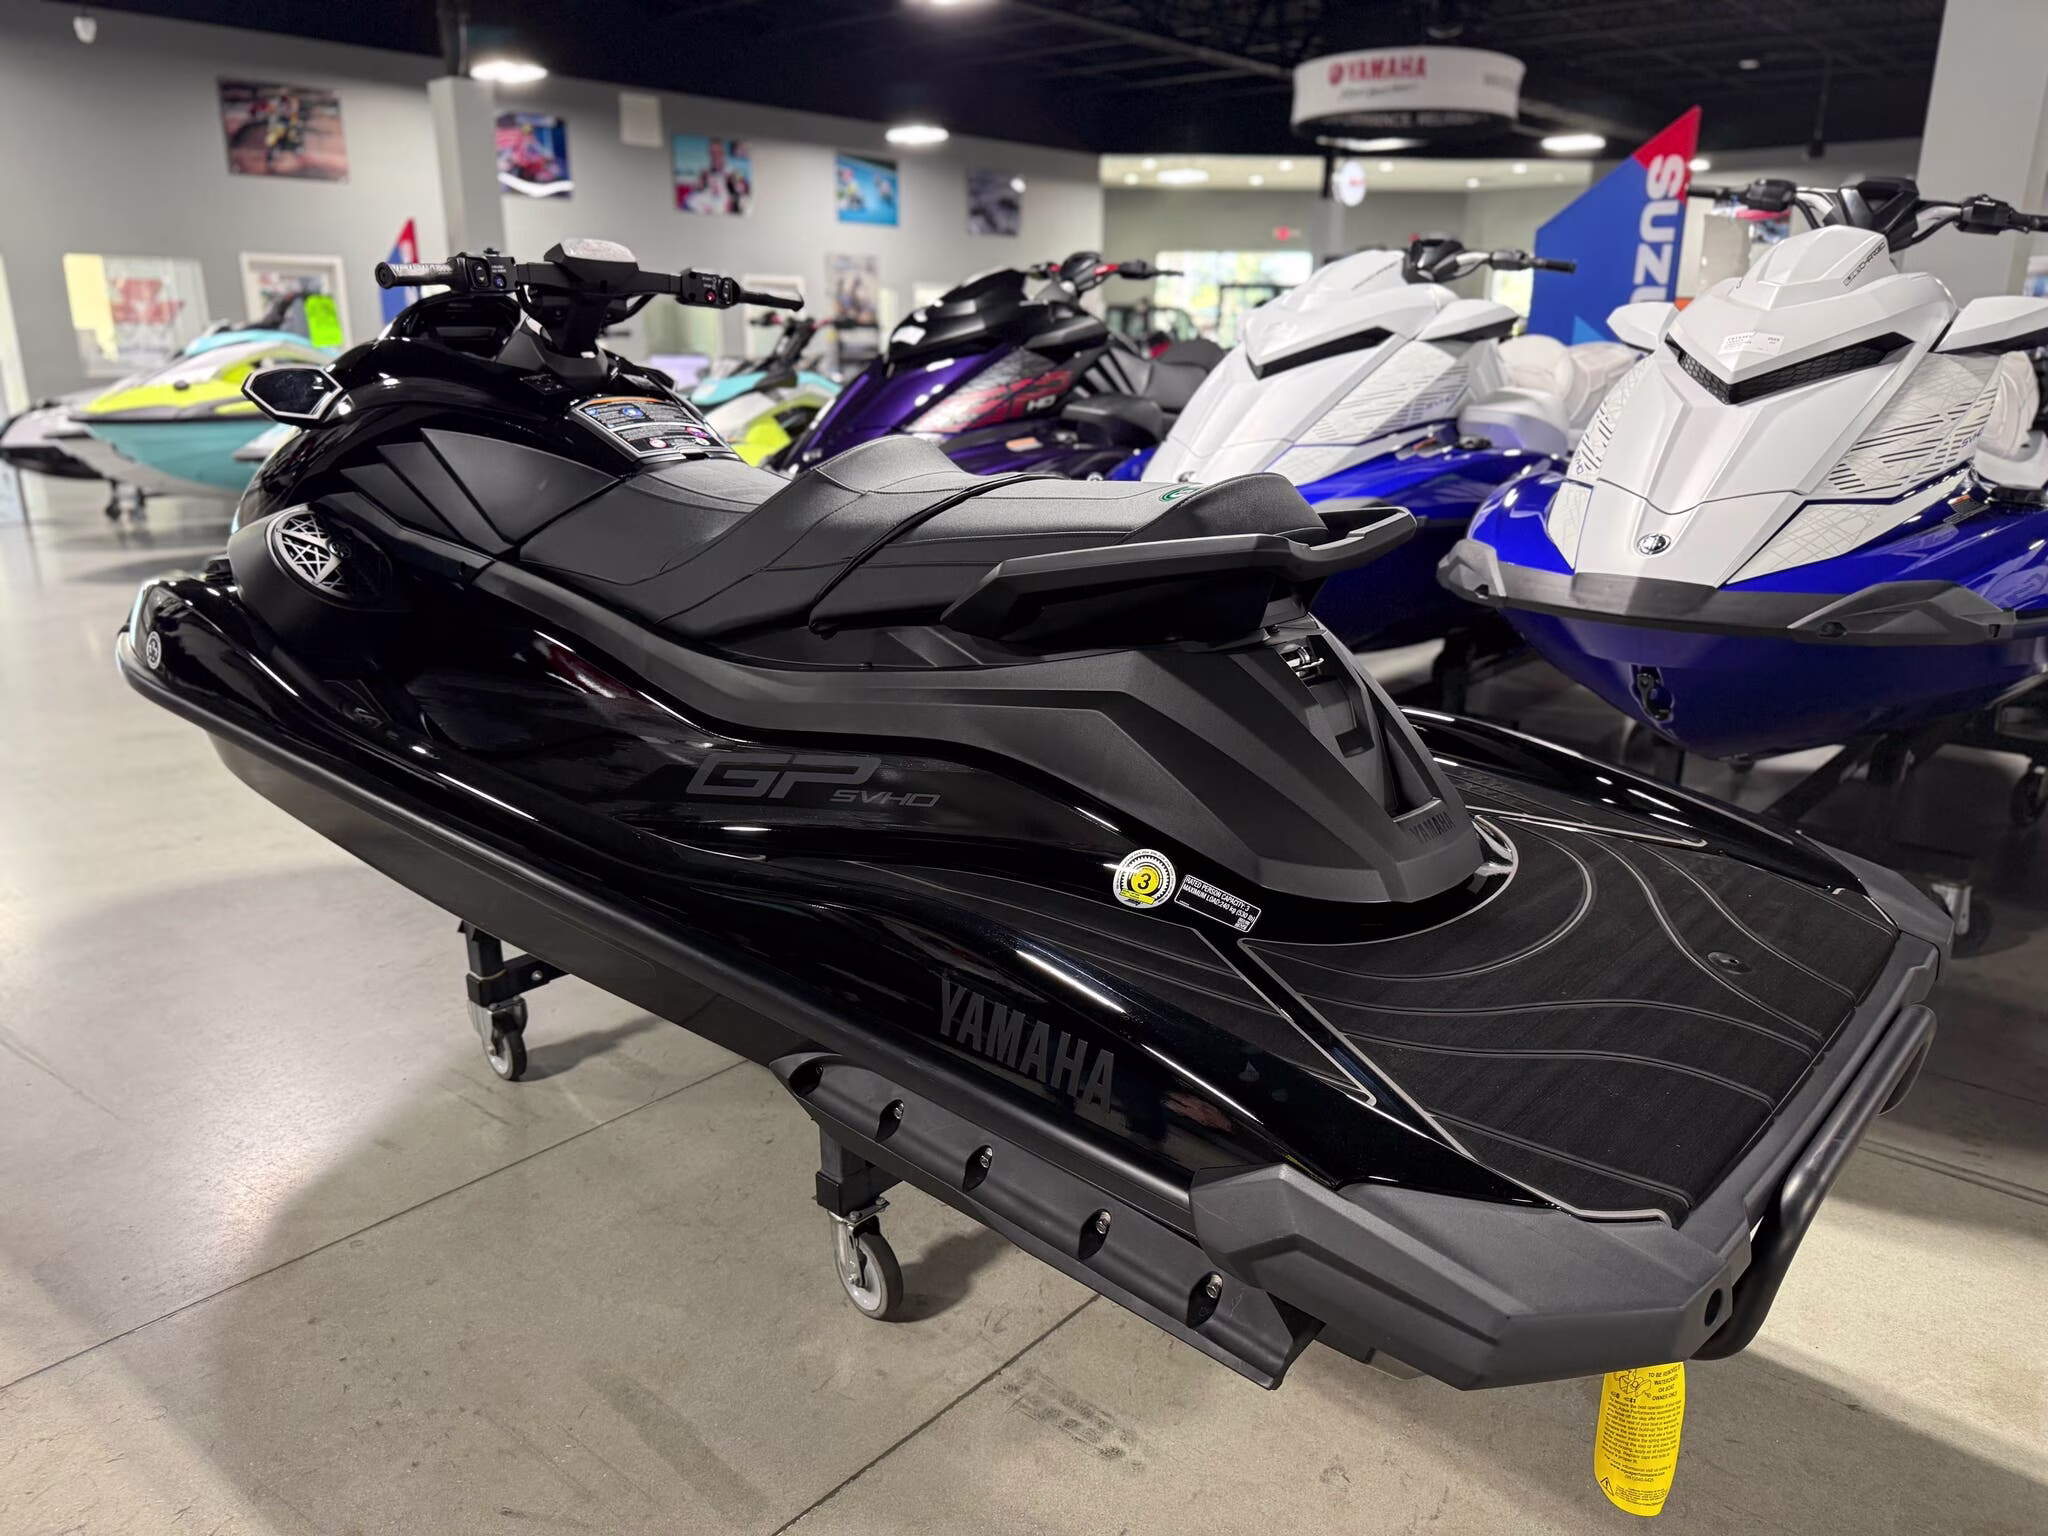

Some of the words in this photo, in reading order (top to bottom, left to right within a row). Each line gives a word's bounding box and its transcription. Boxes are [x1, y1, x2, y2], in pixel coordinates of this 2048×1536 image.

[1349, 56, 1427, 81] YAMAHA
[685, 753, 881, 799] GP
[829, 789, 942, 807] SVHO
[1408, 812, 1456, 844] YAMAHA
[1138, 873, 1151, 889] 3
[1183, 883, 1207, 900] MAXIMUM
[1201, 884, 1222, 898] PERSON
[1221, 893, 1245, 910] CAPACITY:
[939, 977, 1114, 1113] YAMAHA
